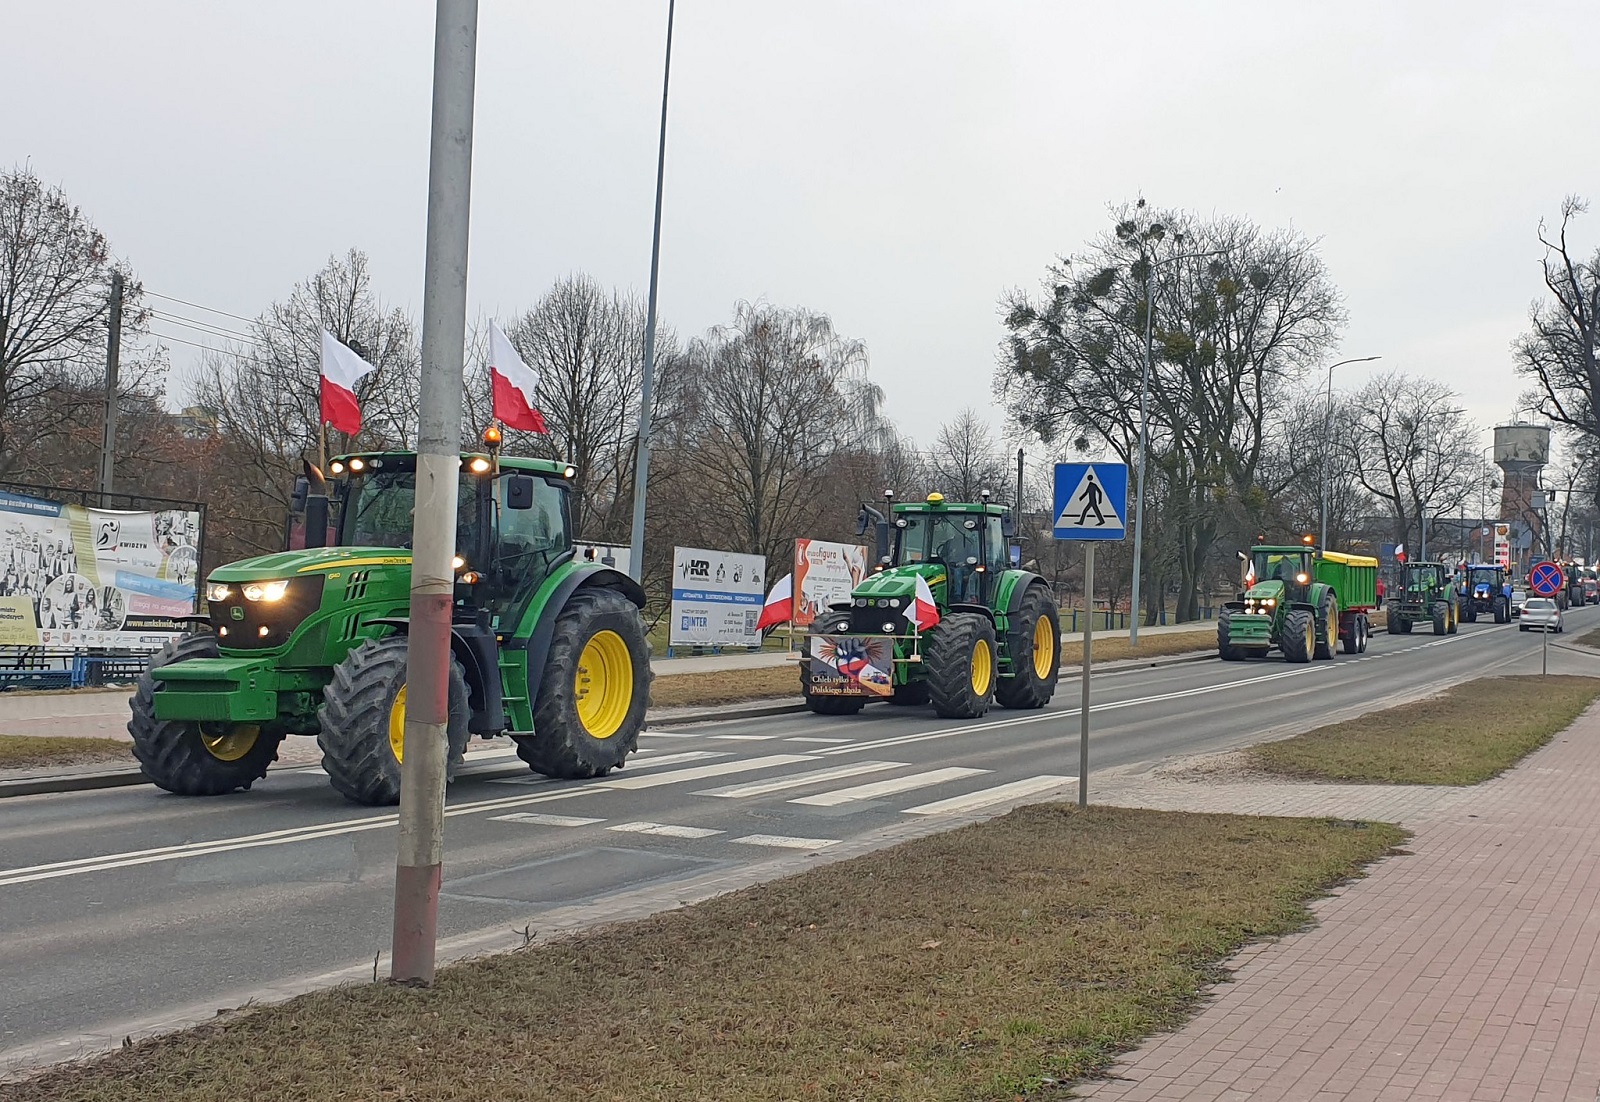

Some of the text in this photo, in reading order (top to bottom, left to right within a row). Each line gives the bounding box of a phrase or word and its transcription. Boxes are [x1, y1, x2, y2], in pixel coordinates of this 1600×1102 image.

[690, 559, 710, 577] KR
[812, 675, 832, 683] Chleb
[832, 675, 850, 685] tylko
[812, 685, 842, 695] Polskiego
